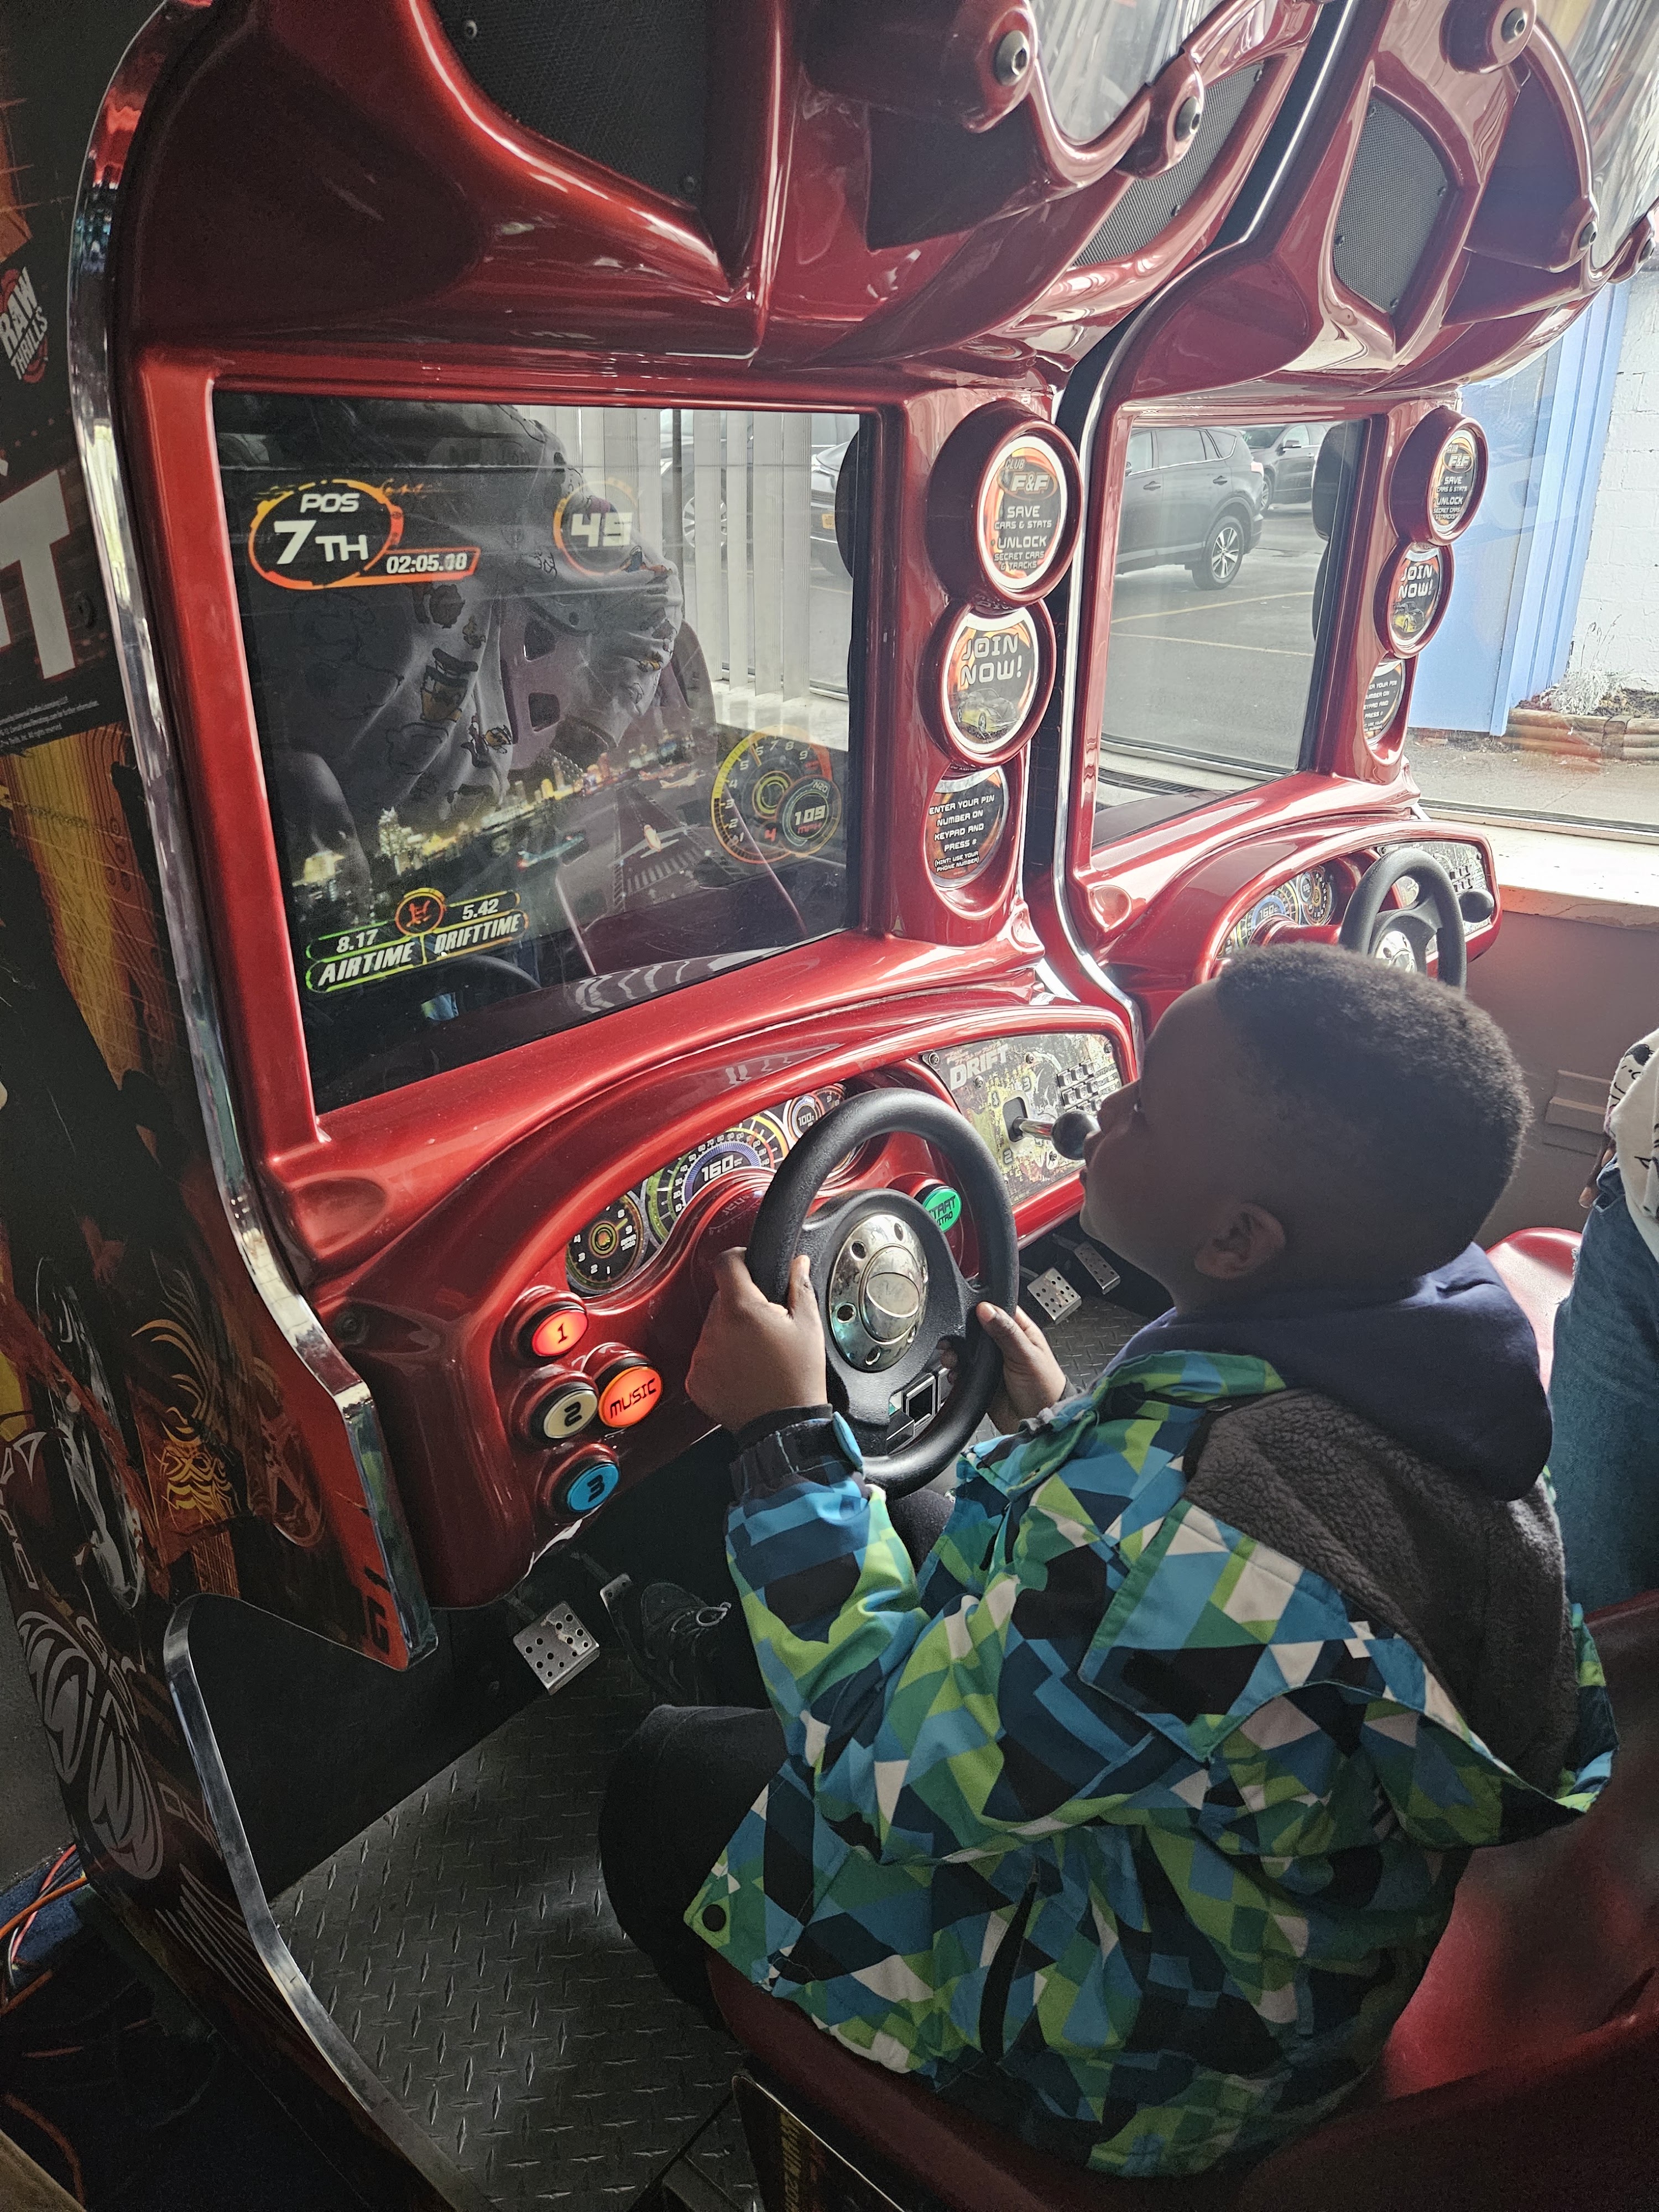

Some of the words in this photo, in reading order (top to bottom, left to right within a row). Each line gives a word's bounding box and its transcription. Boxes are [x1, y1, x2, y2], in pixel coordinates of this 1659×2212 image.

[0, 267, 38, 352] RAW
[11, 305, 48, 380] THRILLS
[1004, 458, 1025, 470] CLUB
[1011, 473, 1050, 493] F&F
[1444, 476, 1463, 485] SAVE
[300, 493, 360, 513] POS
[1436, 497, 1463, 505] UNLOCK
[1007, 505, 1040, 518] SAVE
[994, 521, 1016, 530] CARS
[1019, 520, 1025, 529] &
[1027, 519, 1052, 528] STATS
[998, 535, 1047, 549] UNLOCK
[994, 553, 1023, 562] SECRET
[1025, 551, 1045, 560] CARS
[1000, 562, 1006, 571] &
[1008, 560, 1037, 570] TRACKS
[1400, 565, 1433, 582] JOIN
[1397, 581, 1433, 599] NOW!
[962, 633, 1019, 661] JOIN
[960, 655, 1022, 686] NOW!
[928, 802, 956, 815] ENTER
[958, 797, 979, 809] YOUR
[980, 794, 995, 806] PIN
[795, 805, 826, 826] 109
[937, 814, 971, 827] NUMBER
[972, 809, 984, 819] ON
[933, 828, 966, 842] KEYPAD
[968, 823, 984, 833] AND
[944, 840, 971, 853] PRESS
[936, 863, 955, 873] PHONE
[956, 857, 980, 868] NUMBER)
[952, 854, 964, 862] USE
[964, 851, 979, 859] YOUR
[462, 898, 499, 921] 5.42
[336, 928, 378, 954] 8.17
[318, 941, 416, 987] AIRTIME
[950, 1044, 1008, 1091] DRIFT
[797, 1112, 812, 1126] 100
[1003, 1149, 1013, 1165] 2
[701, 1155, 734, 1182] 160
[578, 1253, 585, 1262] 3
[591, 1264, 598, 1274] 2
[607, 1266, 611, 1274] 1
[557, 1323, 568, 1344] 1
[609, 1377, 657, 1420] MUSIC
[564, 1400, 582, 1428] 2
[586, 1473, 606, 1504] 3
